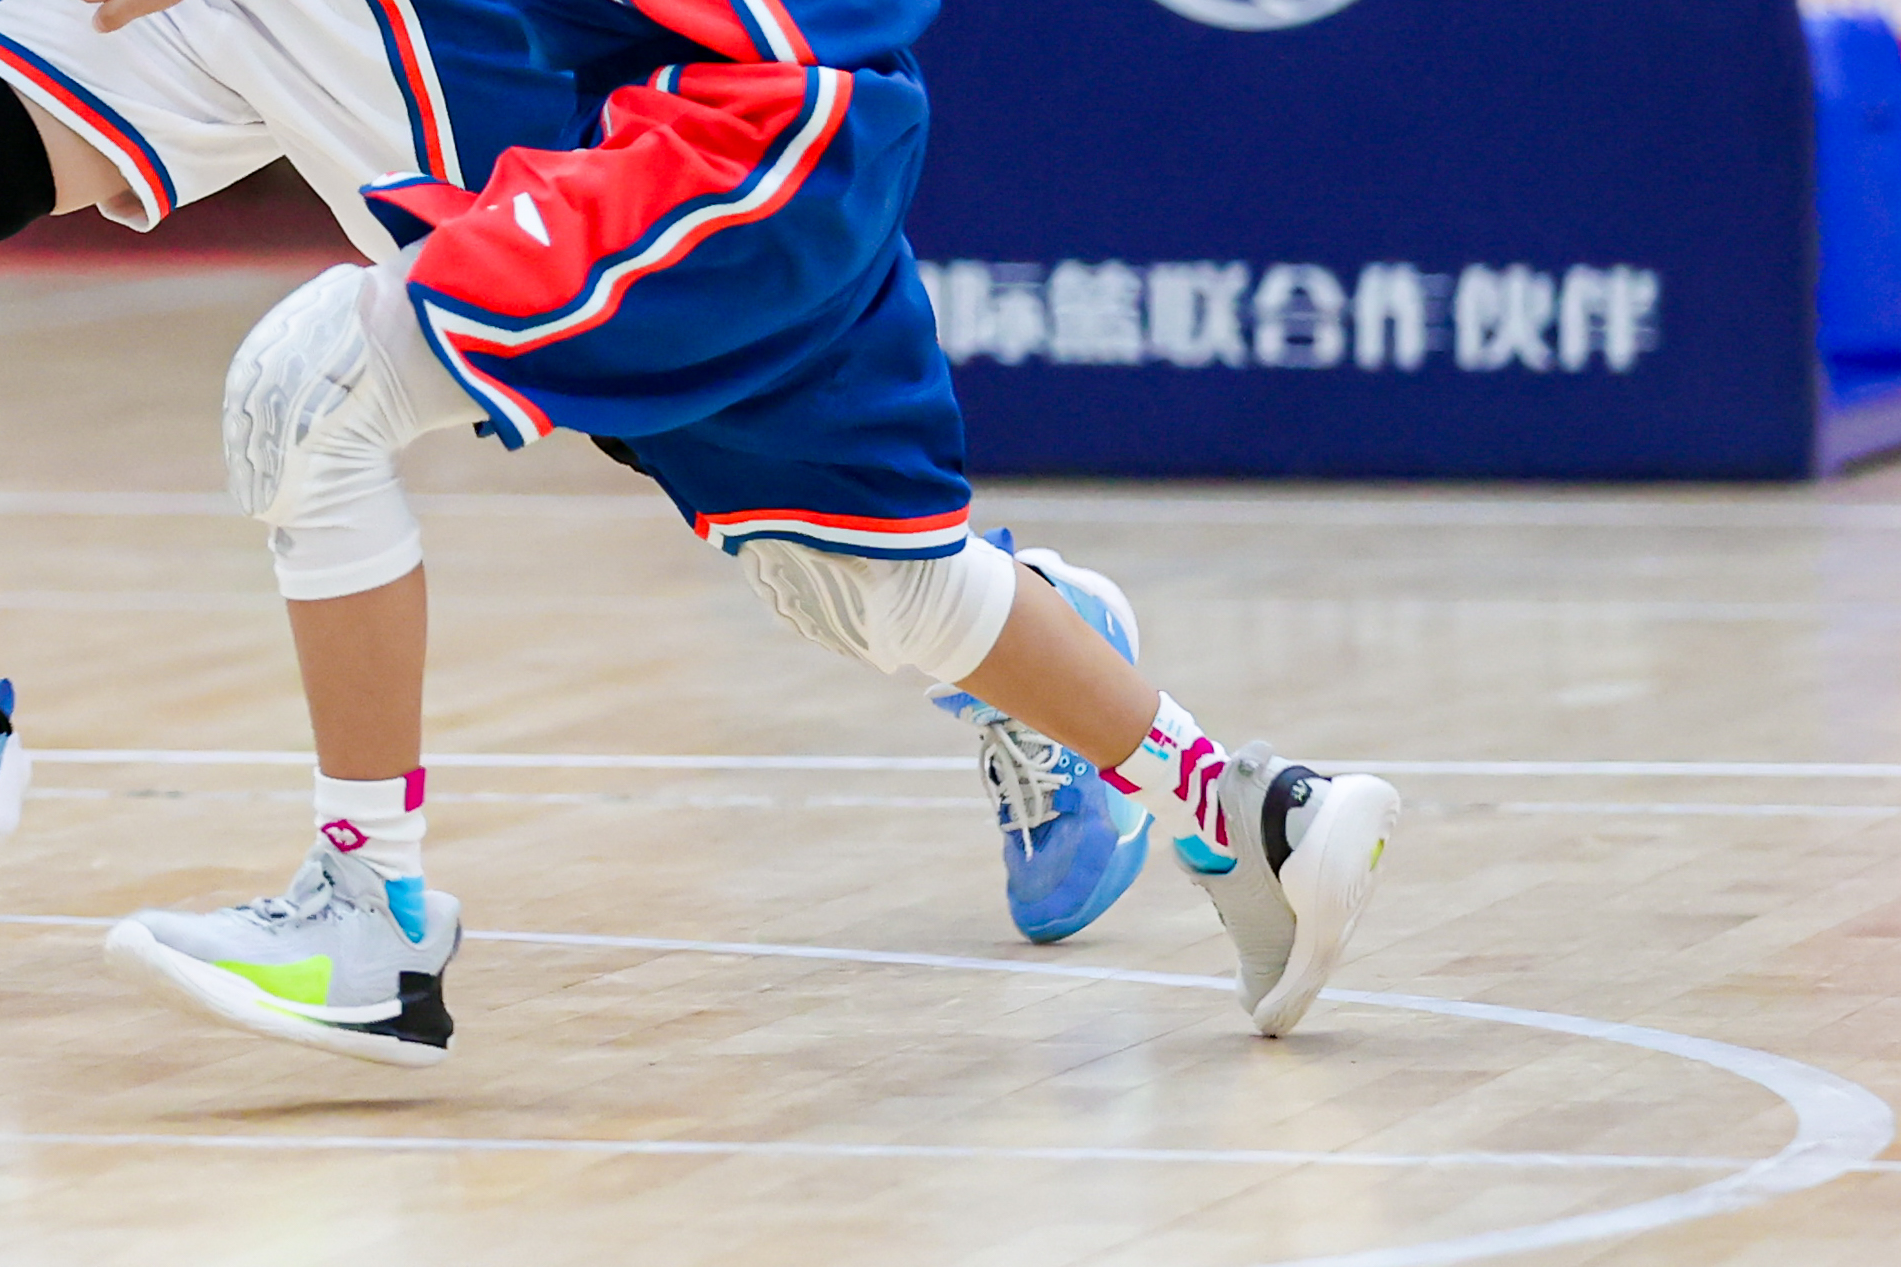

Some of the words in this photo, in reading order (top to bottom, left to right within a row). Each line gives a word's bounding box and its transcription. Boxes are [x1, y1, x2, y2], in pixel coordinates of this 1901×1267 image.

[918, 260, 1657, 370] 际篮联合作伙伴
